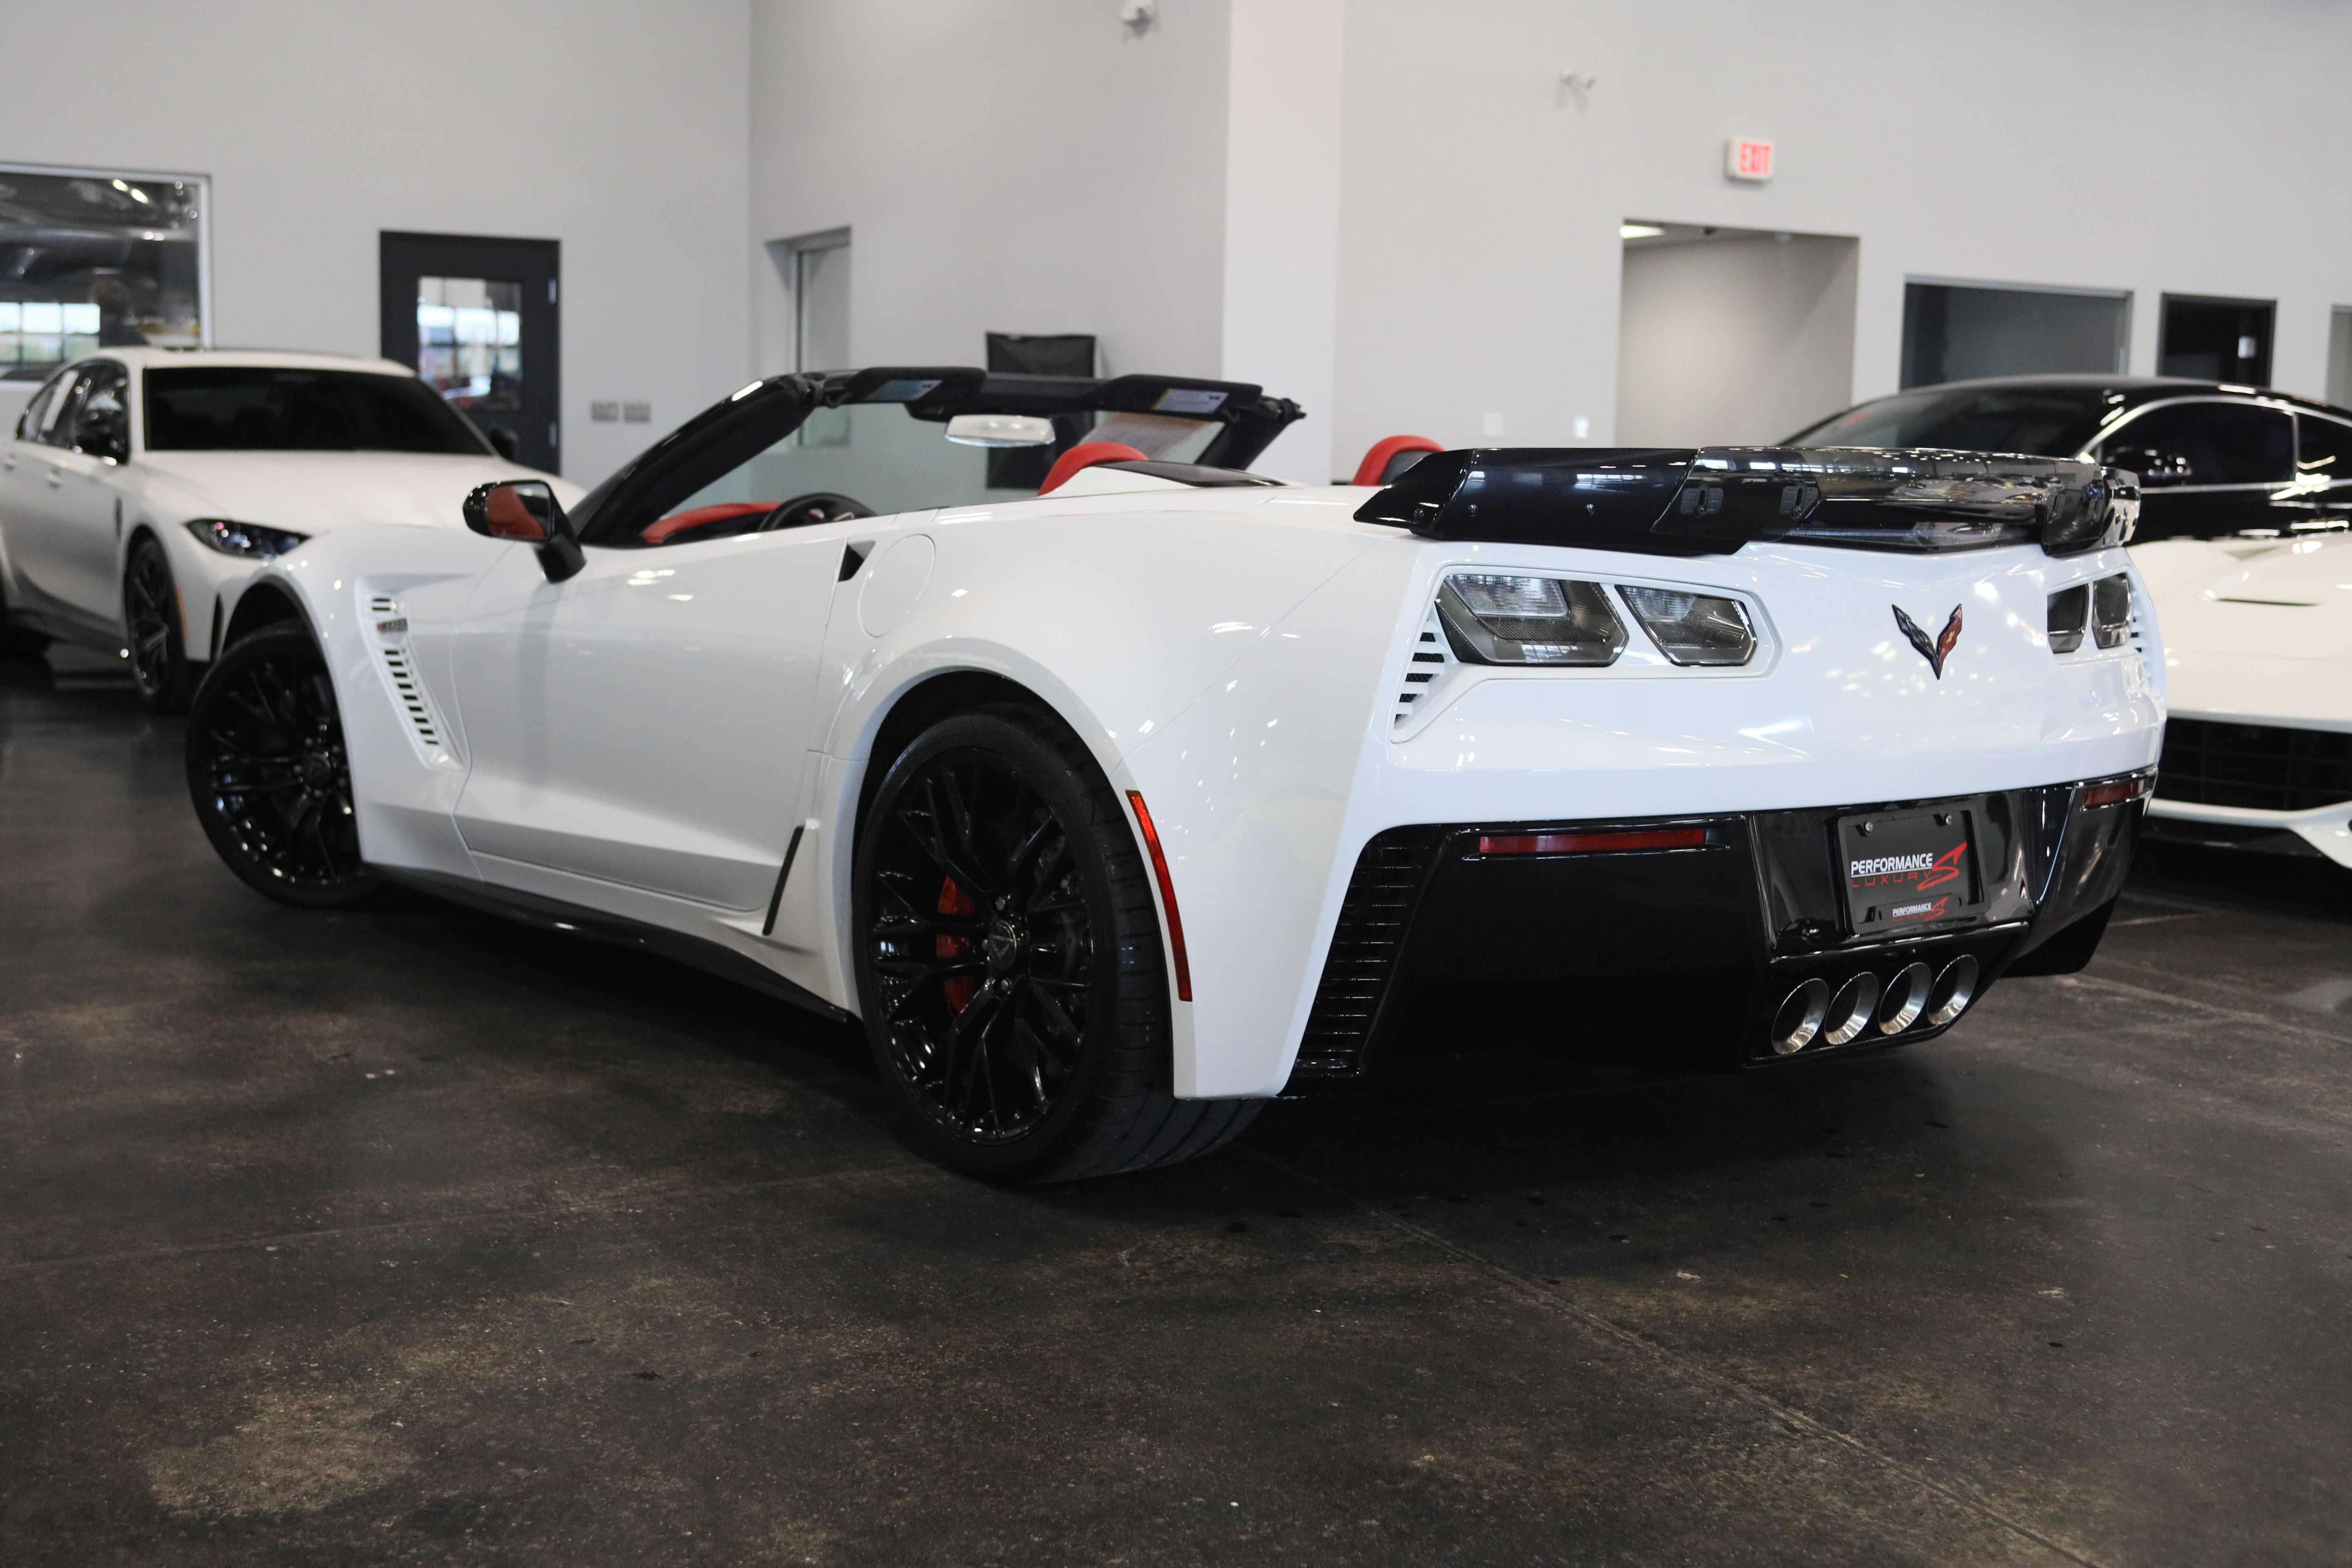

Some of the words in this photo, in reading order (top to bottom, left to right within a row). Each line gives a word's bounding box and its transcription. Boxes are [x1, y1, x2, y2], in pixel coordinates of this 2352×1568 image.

[1851, 853, 1933, 875] PERFORMANCE
[1851, 870, 1931, 887] LUXURY
[1893, 902, 1931, 916] PERFORMANCE
